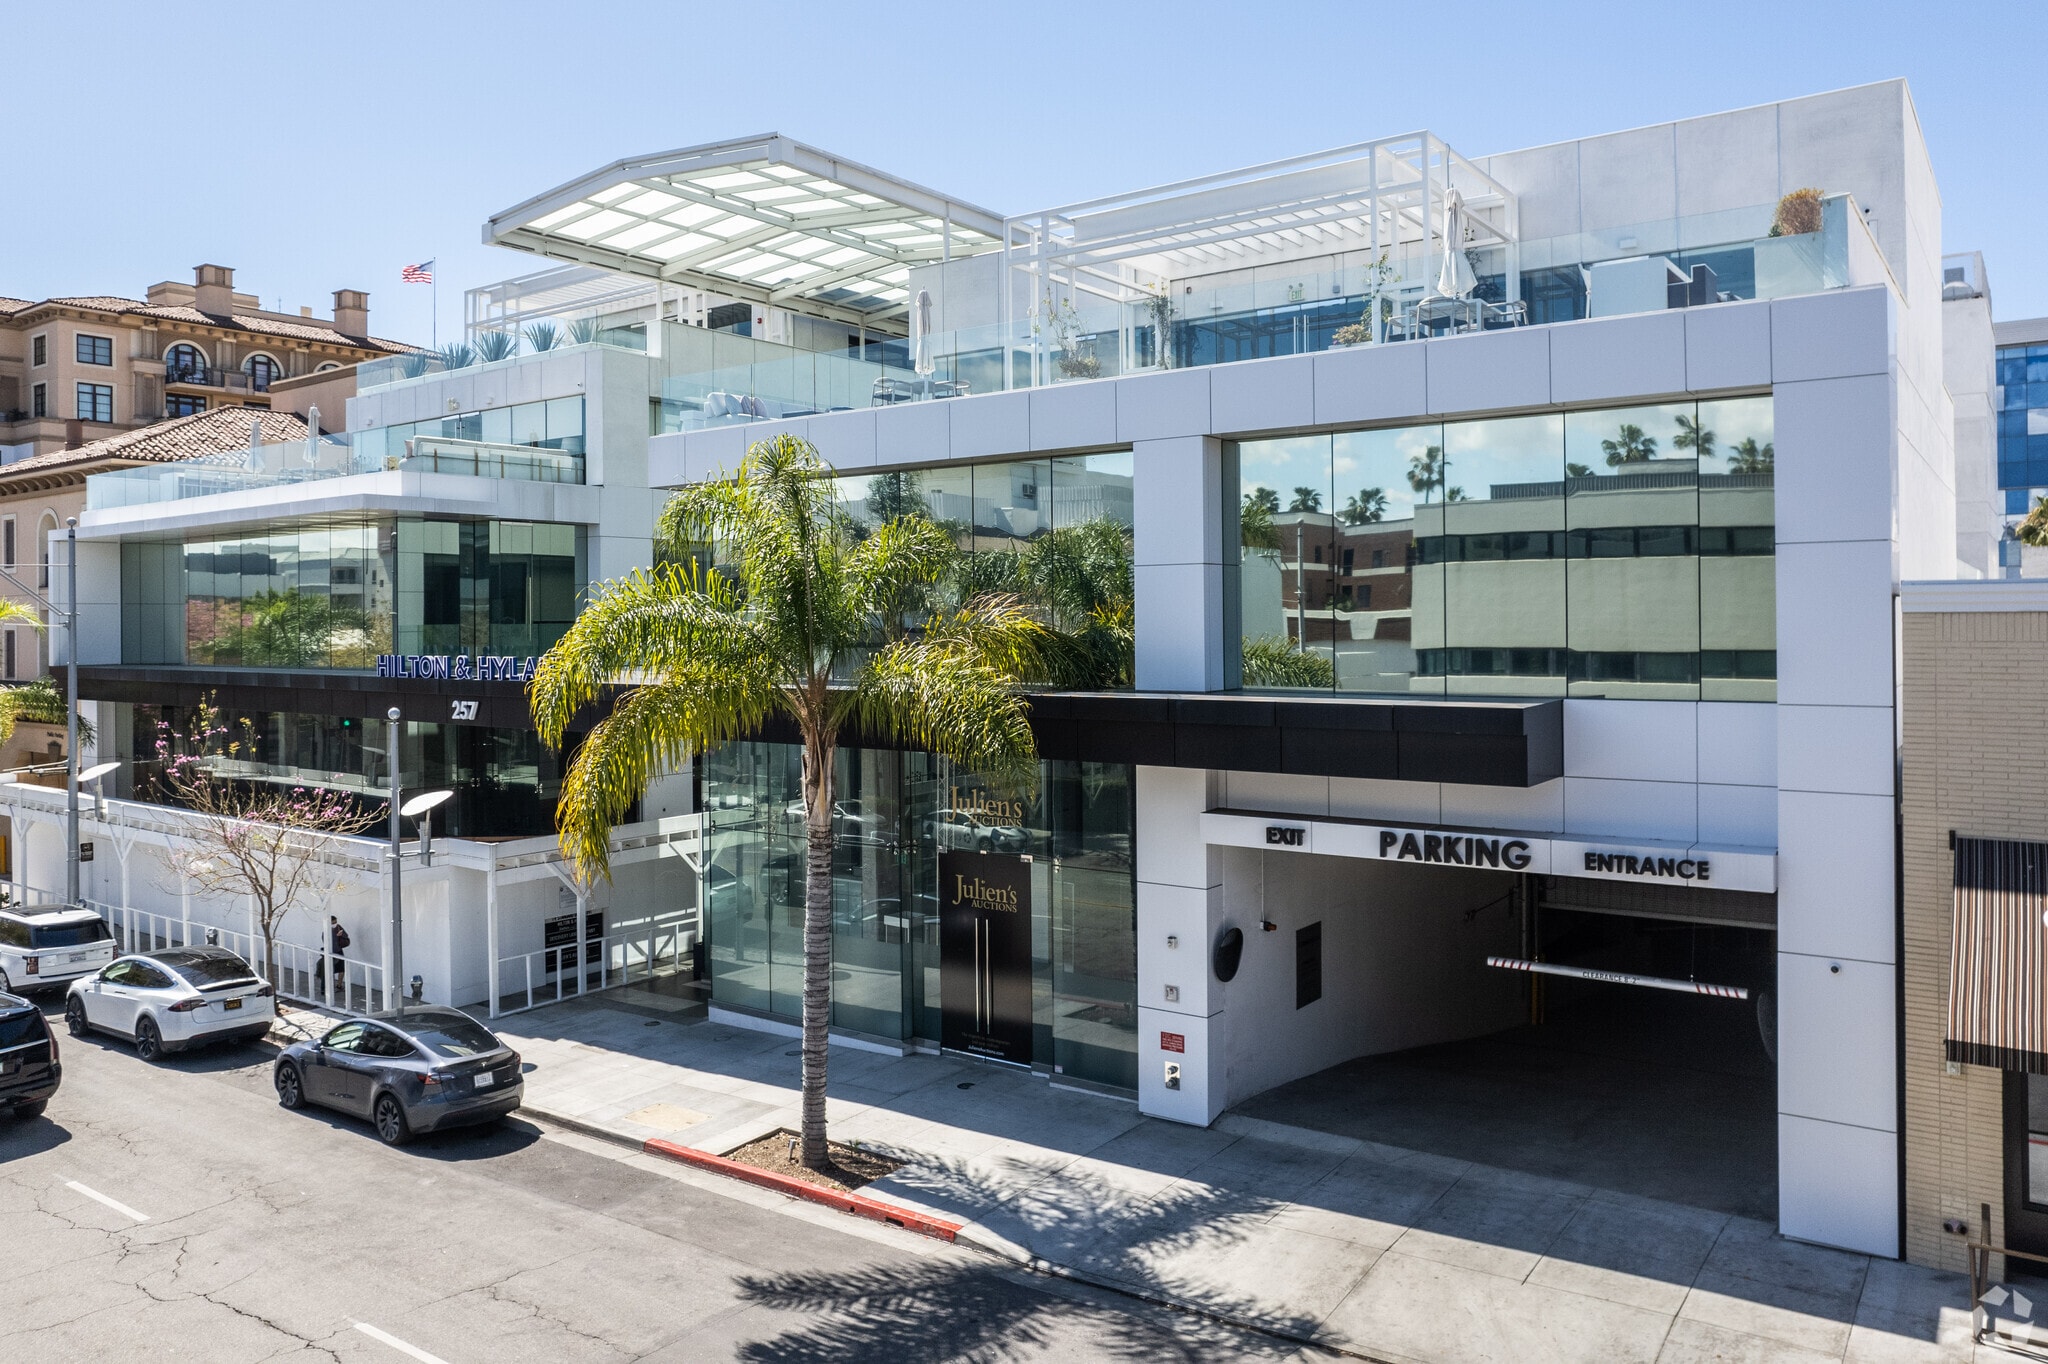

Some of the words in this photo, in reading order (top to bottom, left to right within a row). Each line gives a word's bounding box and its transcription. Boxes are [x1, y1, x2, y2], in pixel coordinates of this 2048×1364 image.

[376, 655, 449, 680] HILTON
[454, 655, 473, 680] &
[477, 656, 551, 682] HYLA
[451, 700, 479, 721] 257
[968, 815, 1023, 828] AUCTIONS
[1266, 826, 1306, 847] EXIT
[1379, 830, 1532, 870] PARKING
[1584, 852, 1710, 881] ENTRANCE
[952, 874, 1018, 906] Julien's
[971, 900, 1018, 914] AUCTIONS
[1582, 971, 1622, 983] CLEARANCE
